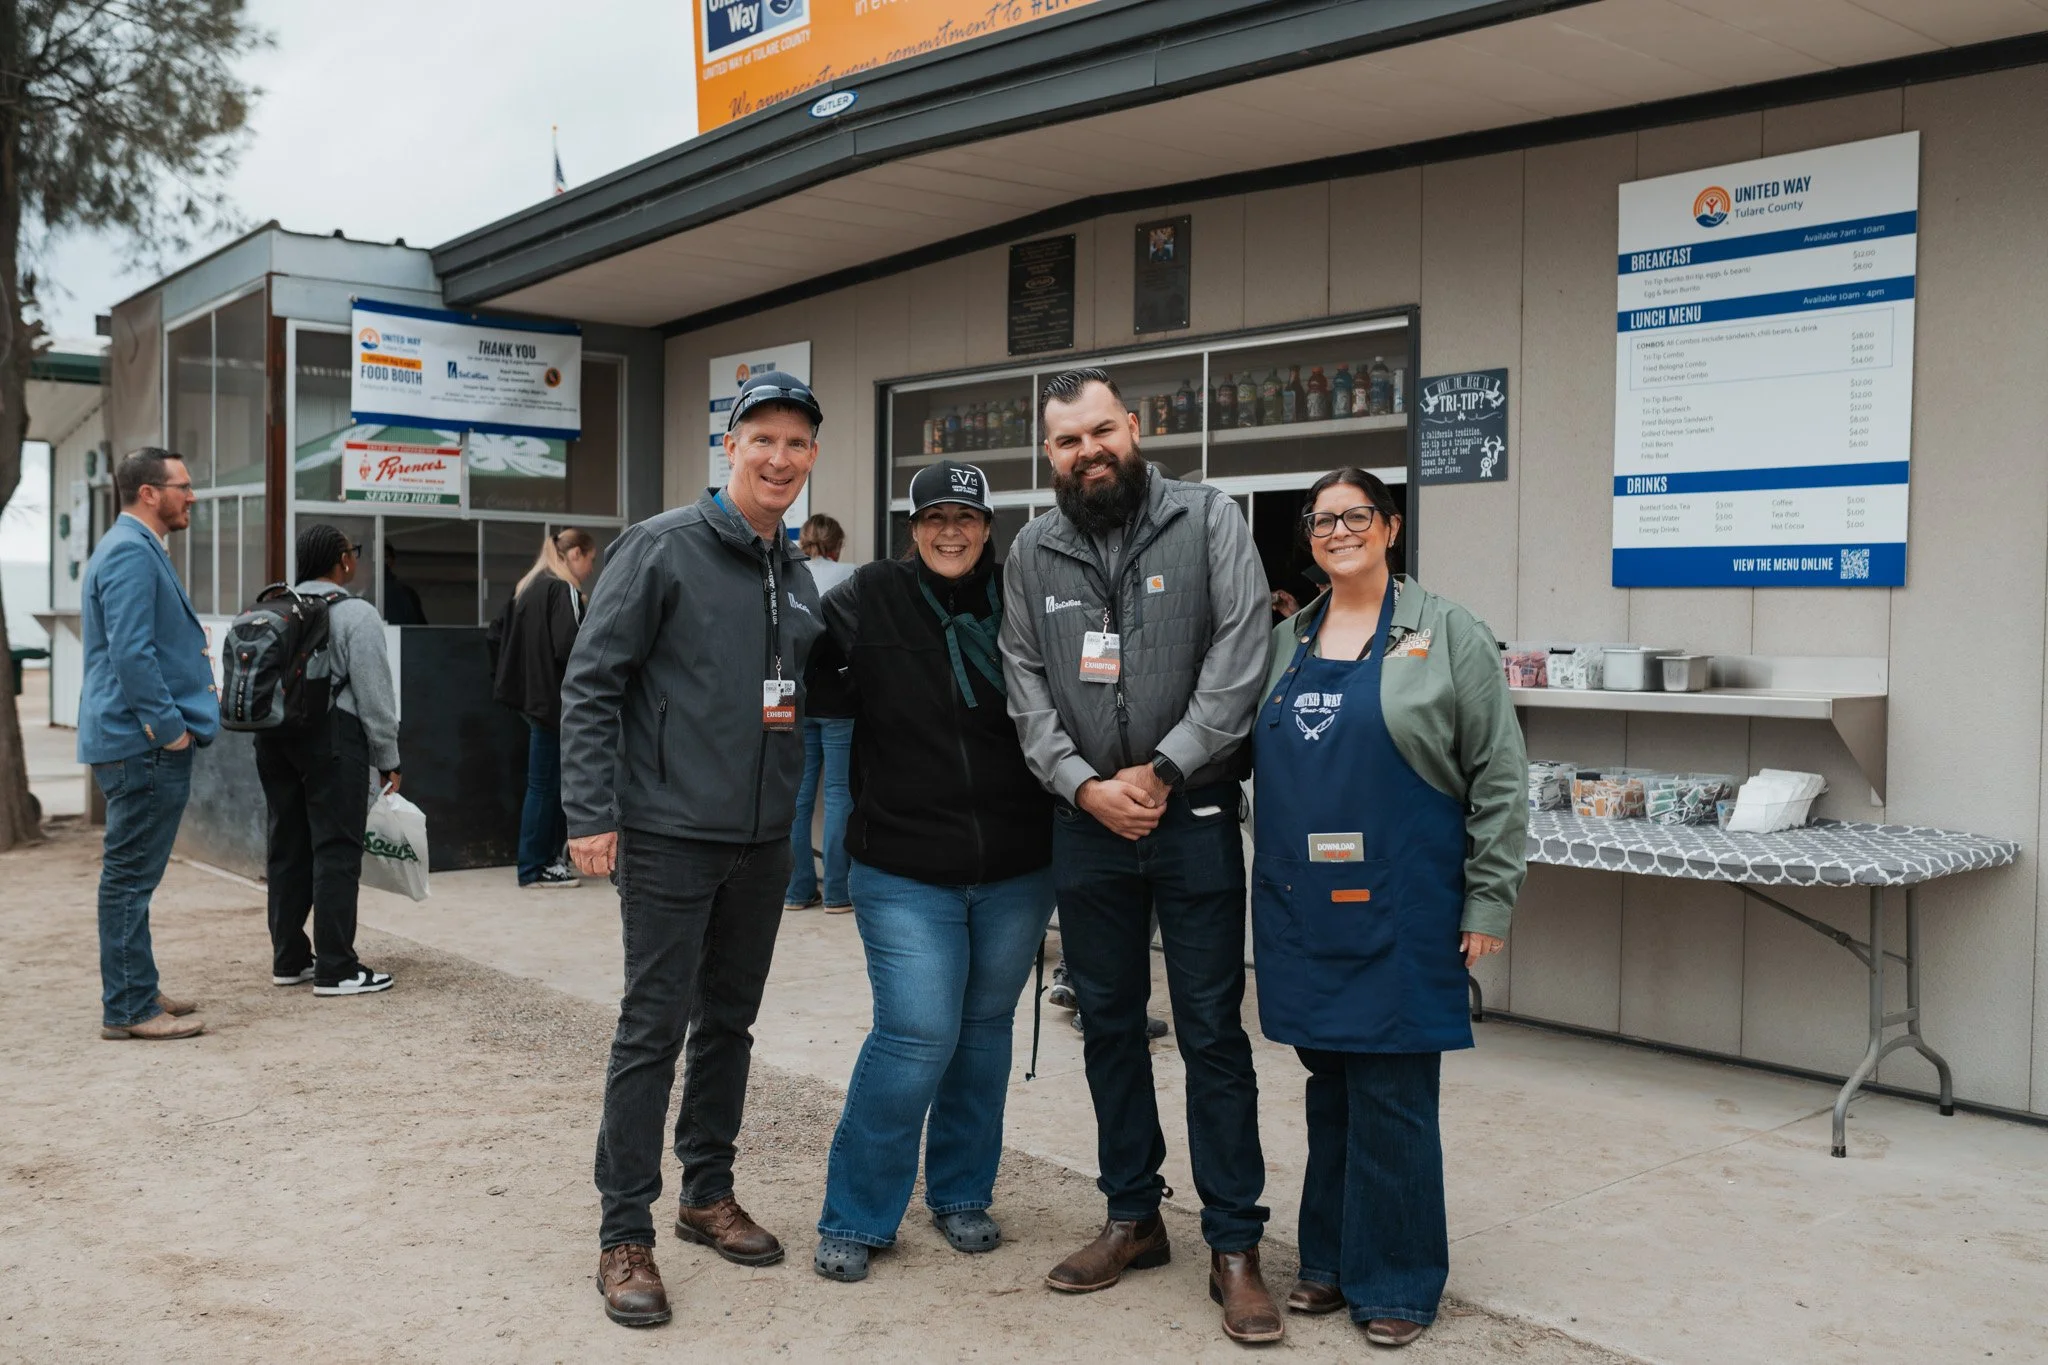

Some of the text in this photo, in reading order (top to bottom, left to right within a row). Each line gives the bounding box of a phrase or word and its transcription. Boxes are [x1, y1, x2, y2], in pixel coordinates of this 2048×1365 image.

[727, 3, 760, 32] Way
[703, 61, 728, 80] UNITED
[729, 55, 743, 71] WAY
[752, 41, 780, 62] TULARE
[780, 29, 810, 51] COUNTY
[729, 90, 752, 118] We
[885, 3, 999, 63] commitment
[816, 95, 849, 114] BUTLER
[1735, 175, 1812, 203] UNITED WAY
[1735, 201, 1803, 218] Tulare County
[1803, 224, 1886, 243] Available 7am 10am
[1631, 247, 1692, 271] BREAKFAST
[1853, 249, 1876, 259] $12.00
[1853, 262, 1873, 272] $8.00
[1664, 274, 1685, 283] Burrito
[1644, 290, 1655, 299] Egg
[1803, 288, 1885, 304] Available 10am 4pm
[1630, 305, 1702, 329] LUNCH MENU
[1676, 337, 1699, 346] Combos
[1701, 333, 1724, 342] include
[1801, 322, 1818, 332] drink
[381, 334, 421, 346] UNITED WAY
[479, 340, 536, 359] THANK YOU
[1663, 351, 1684, 359] Combo
[1659, 362, 1683, 371] Bologna
[1685, 360, 1707, 369] Combo
[1851, 356, 1874, 365] $14.00
[361, 365, 423, 385] FOOD BOOTH
[1663, 373, 1685, 381] Cheese
[1686, 371, 1709, 380] Combo
[1850, 378, 1873, 387] $12.00
[1850, 391, 1872, 400] $12.00
[1439, 391, 1485, 412] TRI-TIP?
[1662, 405, 1691, 414] Sandwich
[1684, 415, 1713, 424] Sandwich
[1426, 430, 1453, 440] California
[1662, 428, 1684, 436] Cheese
[1685, 426, 1715, 435] Sandwich
[1441, 439, 1447, 447] is
[1454, 436, 1482, 447] triangular
[1656, 440, 1674, 448] Beans
[1421, 446, 1471, 458] sirloin cut of beef
[1421, 456, 1456, 467] known for its
[375, 456, 447, 482] Pyrenees
[1421, 467, 1443, 477] superior
[1627, 476, 1667, 494] DRINKS
[364, 490, 442, 504] SERVED HERE
[1847, 496, 1866, 504] $1.00
[1772, 499, 1793, 507] Coffee
[1772, 511, 1784, 519] Tea
[1846, 508, 1865, 517] $1.00
[1639, 525, 1680, 534] Energy Drinks
[1785, 522, 1805, 530] Cocoa
[1733, 557, 1833, 572] VIEW THE MENU ONLINE
[1084, 661, 1117, 671] EXHIBITOR
[1322, 693, 1343, 707] WAY
[1317, 843, 1356, 851] DOWNLOAD
